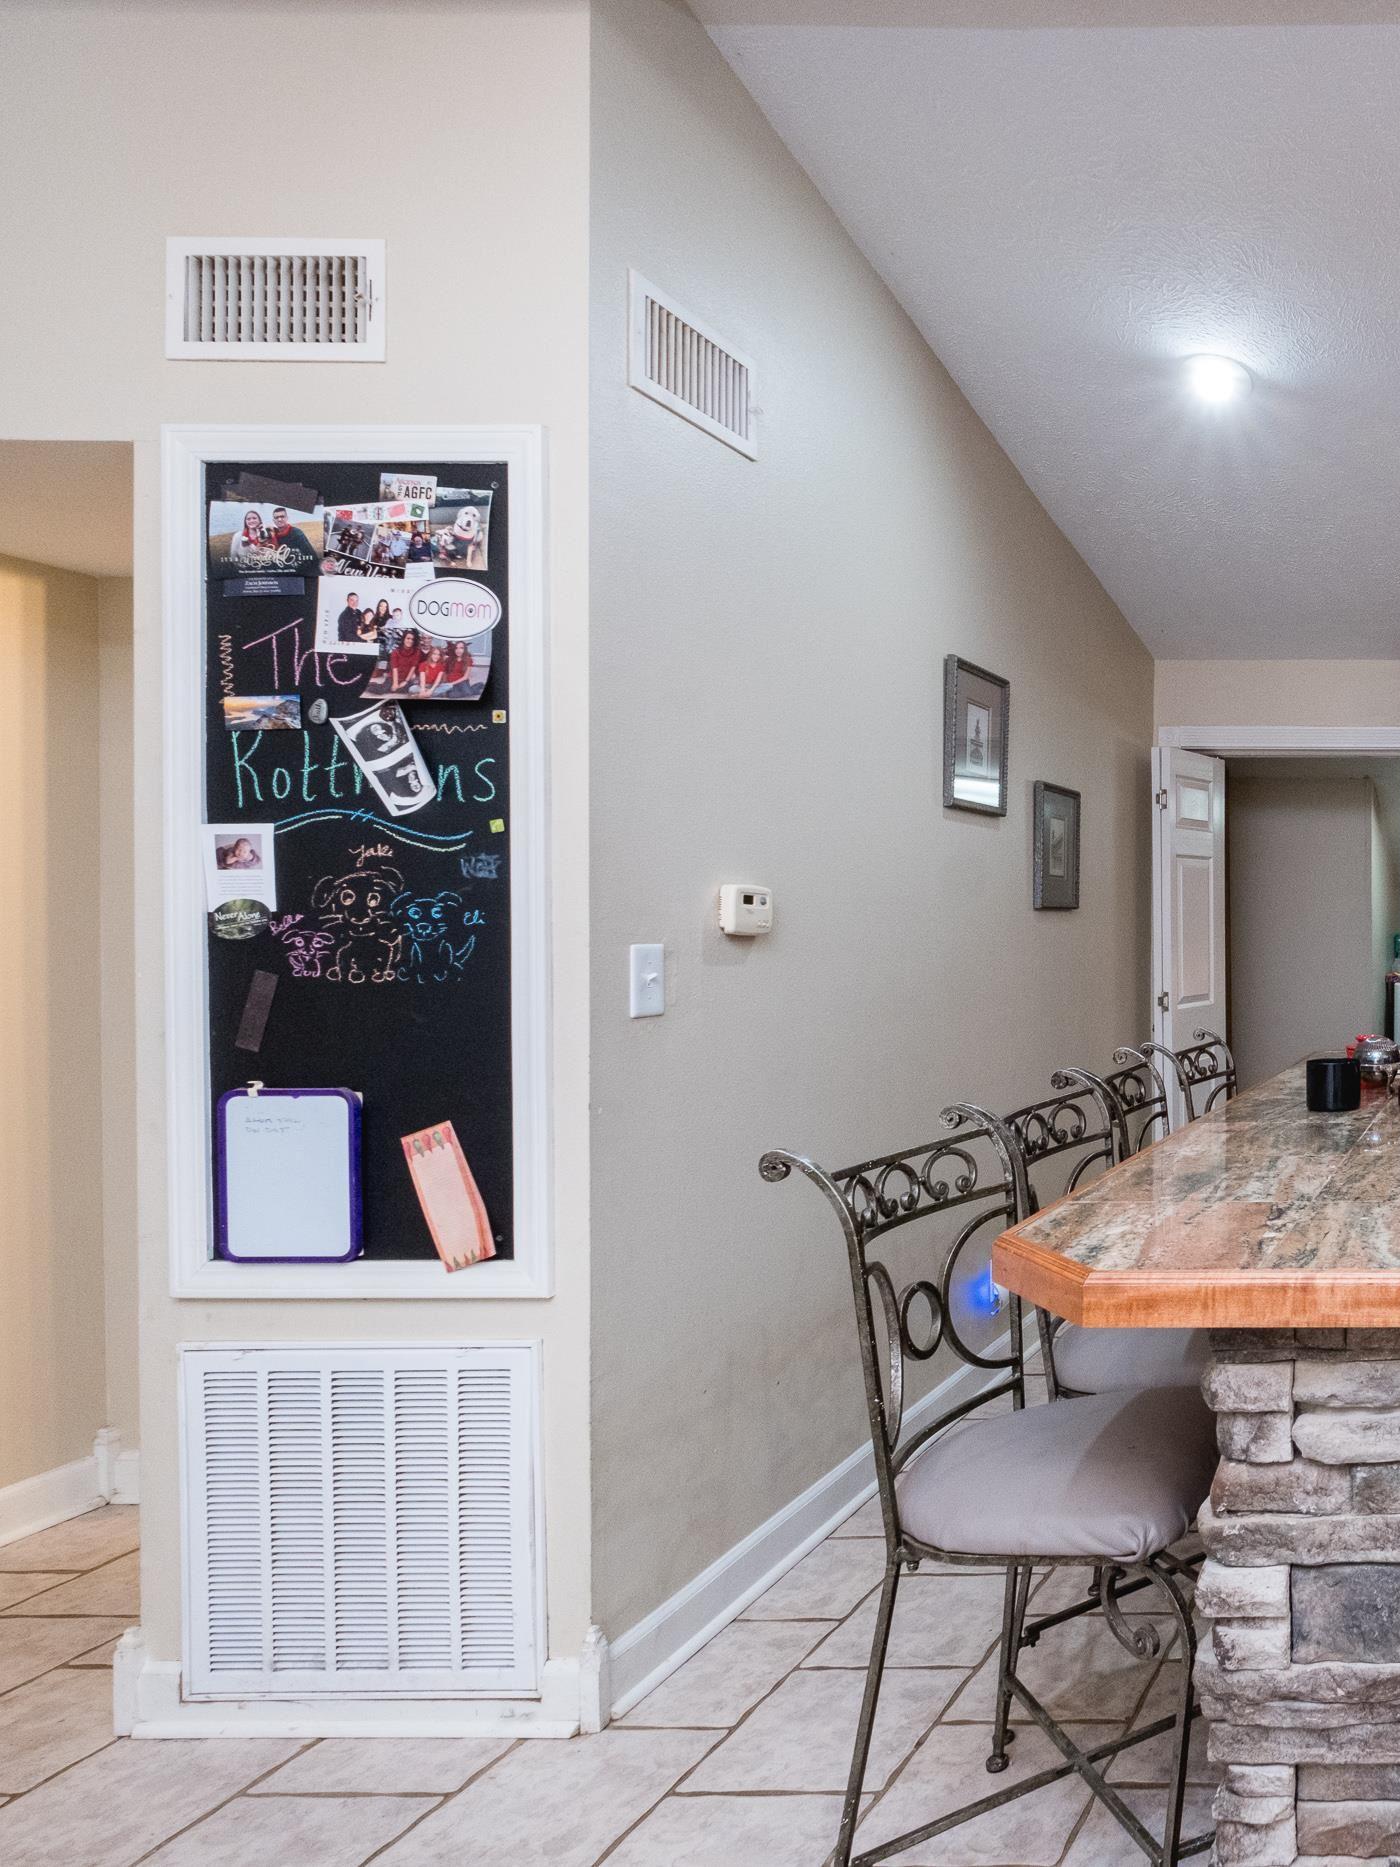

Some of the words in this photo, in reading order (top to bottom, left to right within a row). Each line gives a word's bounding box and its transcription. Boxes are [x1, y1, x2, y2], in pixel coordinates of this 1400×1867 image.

[404, 486, 432, 500] AGFC
[242, 618, 361, 689] The
[214, 911, 238, 921] Never
[238, 911, 261, 921] Alone
[463, 909, 486, 925] Eli
